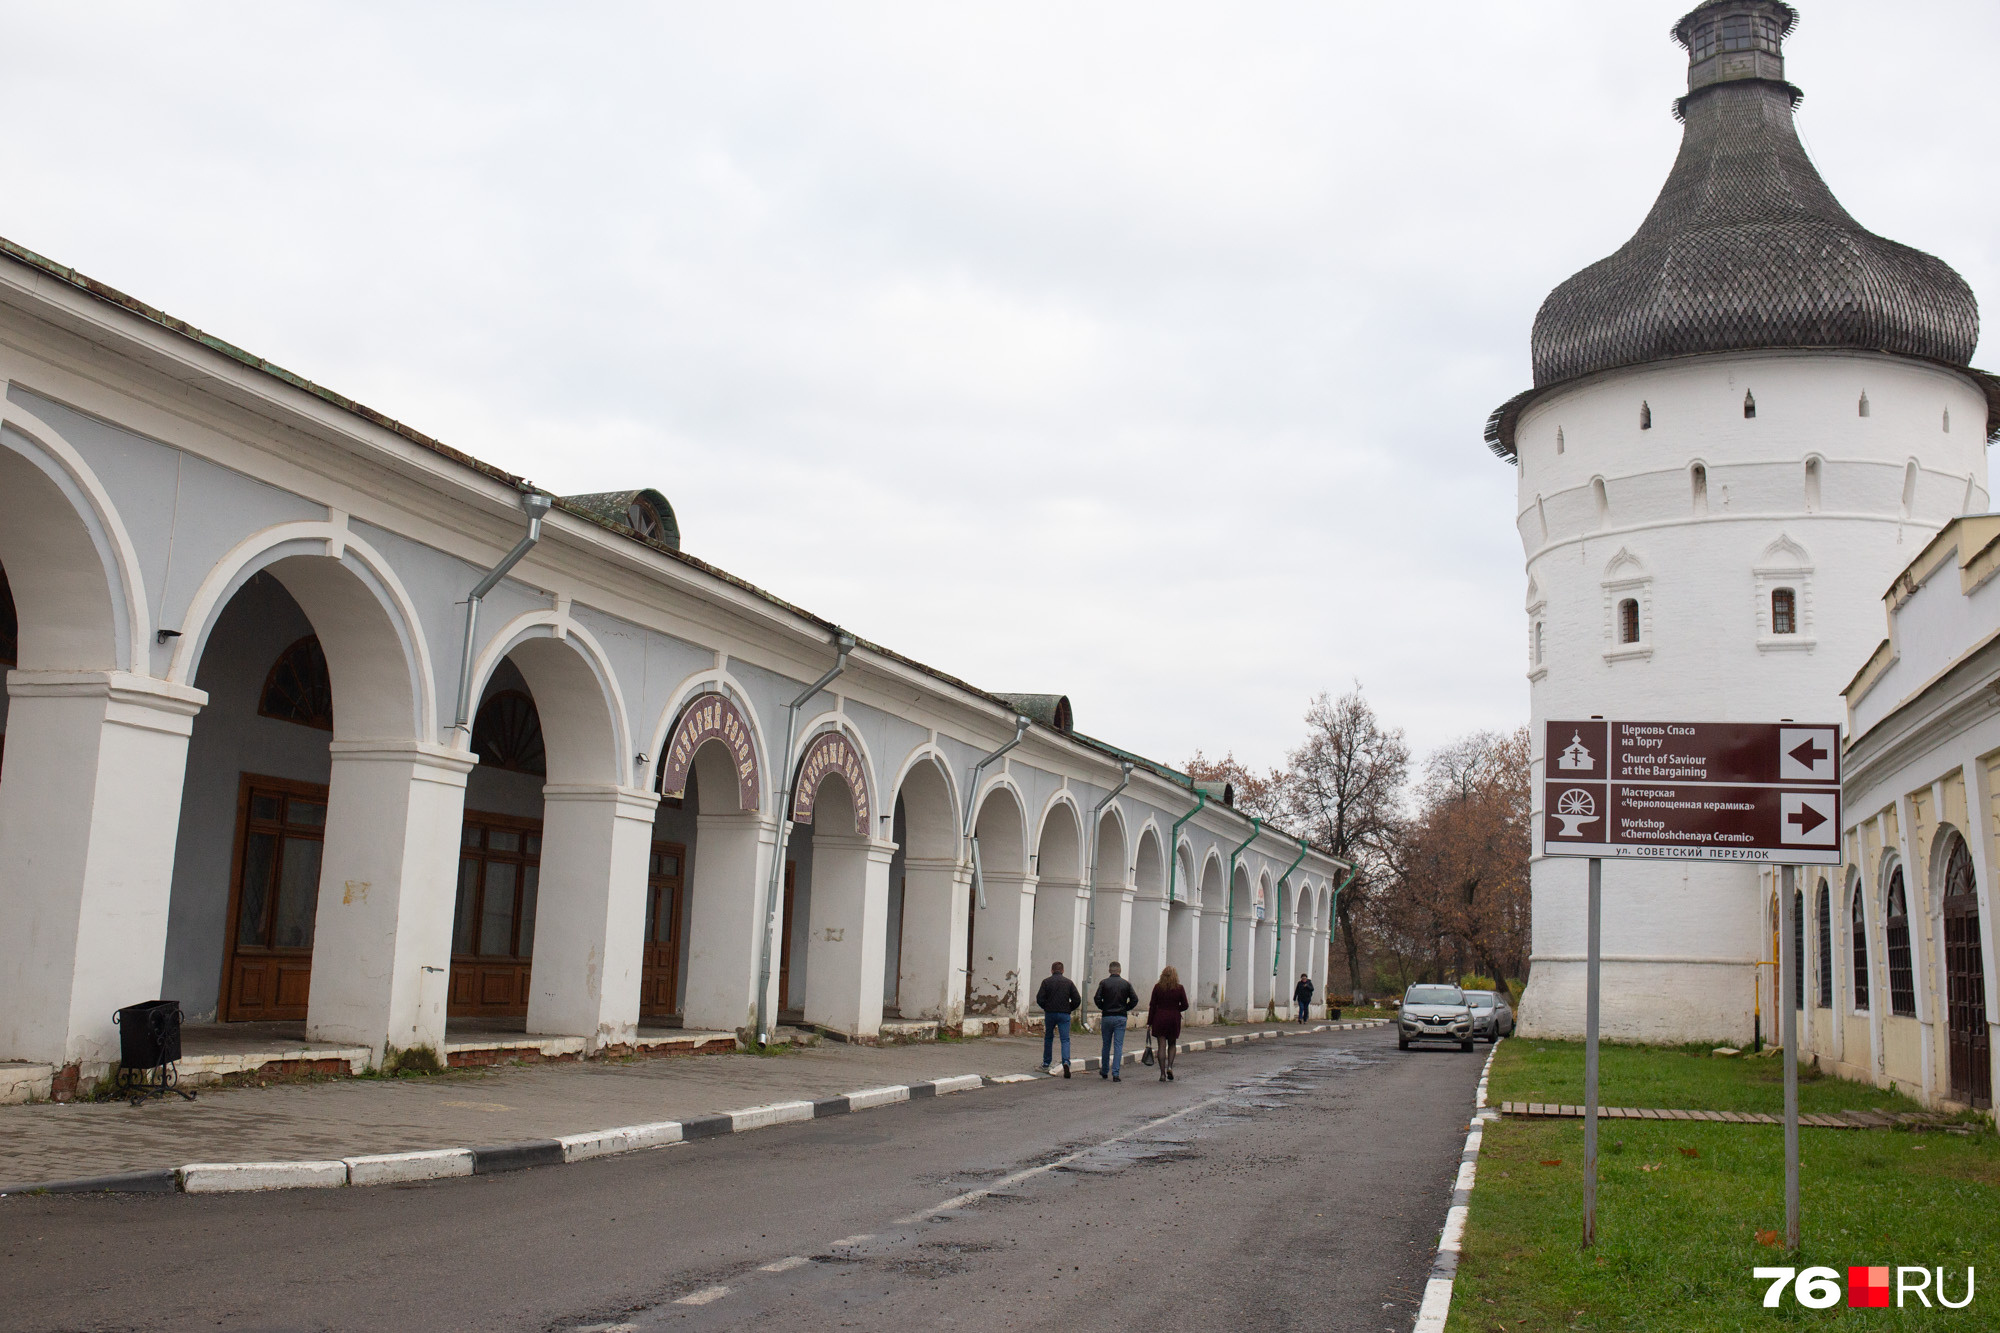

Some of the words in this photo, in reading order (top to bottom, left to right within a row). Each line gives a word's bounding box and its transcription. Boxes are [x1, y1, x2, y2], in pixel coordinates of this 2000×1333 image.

[1622, 724, 1665, 736] Церковь
[1666, 725, 1696, 735] Спаса
[675, 702, 721, 764] СТАРЫЙ
[724, 712, 753, 779] ГОРОД
[1621, 738, 1634, 746] на
[1636, 736, 1663, 748] Торгу
[1622, 753, 1655, 764] Church
[1656, 753, 1668, 764] of
[1669, 754, 1706, 765] Saviour
[1621, 766, 1632, 775] at
[1634, 765, 1651, 775] the
[1653, 766, 1707, 779] Bargaining
[1621, 787, 1675, 798] Мастерская
[1621, 798, 1702, 810] «Чернолощенная
[1703, 801, 1755, 812] керамика»
[1621, 818, 1665, 830] Workshop
[1621, 829, 1712, 843] «Chernoloshchenaya
[1713, 831, 1754, 842] Ceramic»
[1616, 847, 1631, 856] ул.
[1636, 846, 1702, 857] СОВЕТСКИЙ
[1709, 849, 1769, 859] ПЕРЕУЛОК
